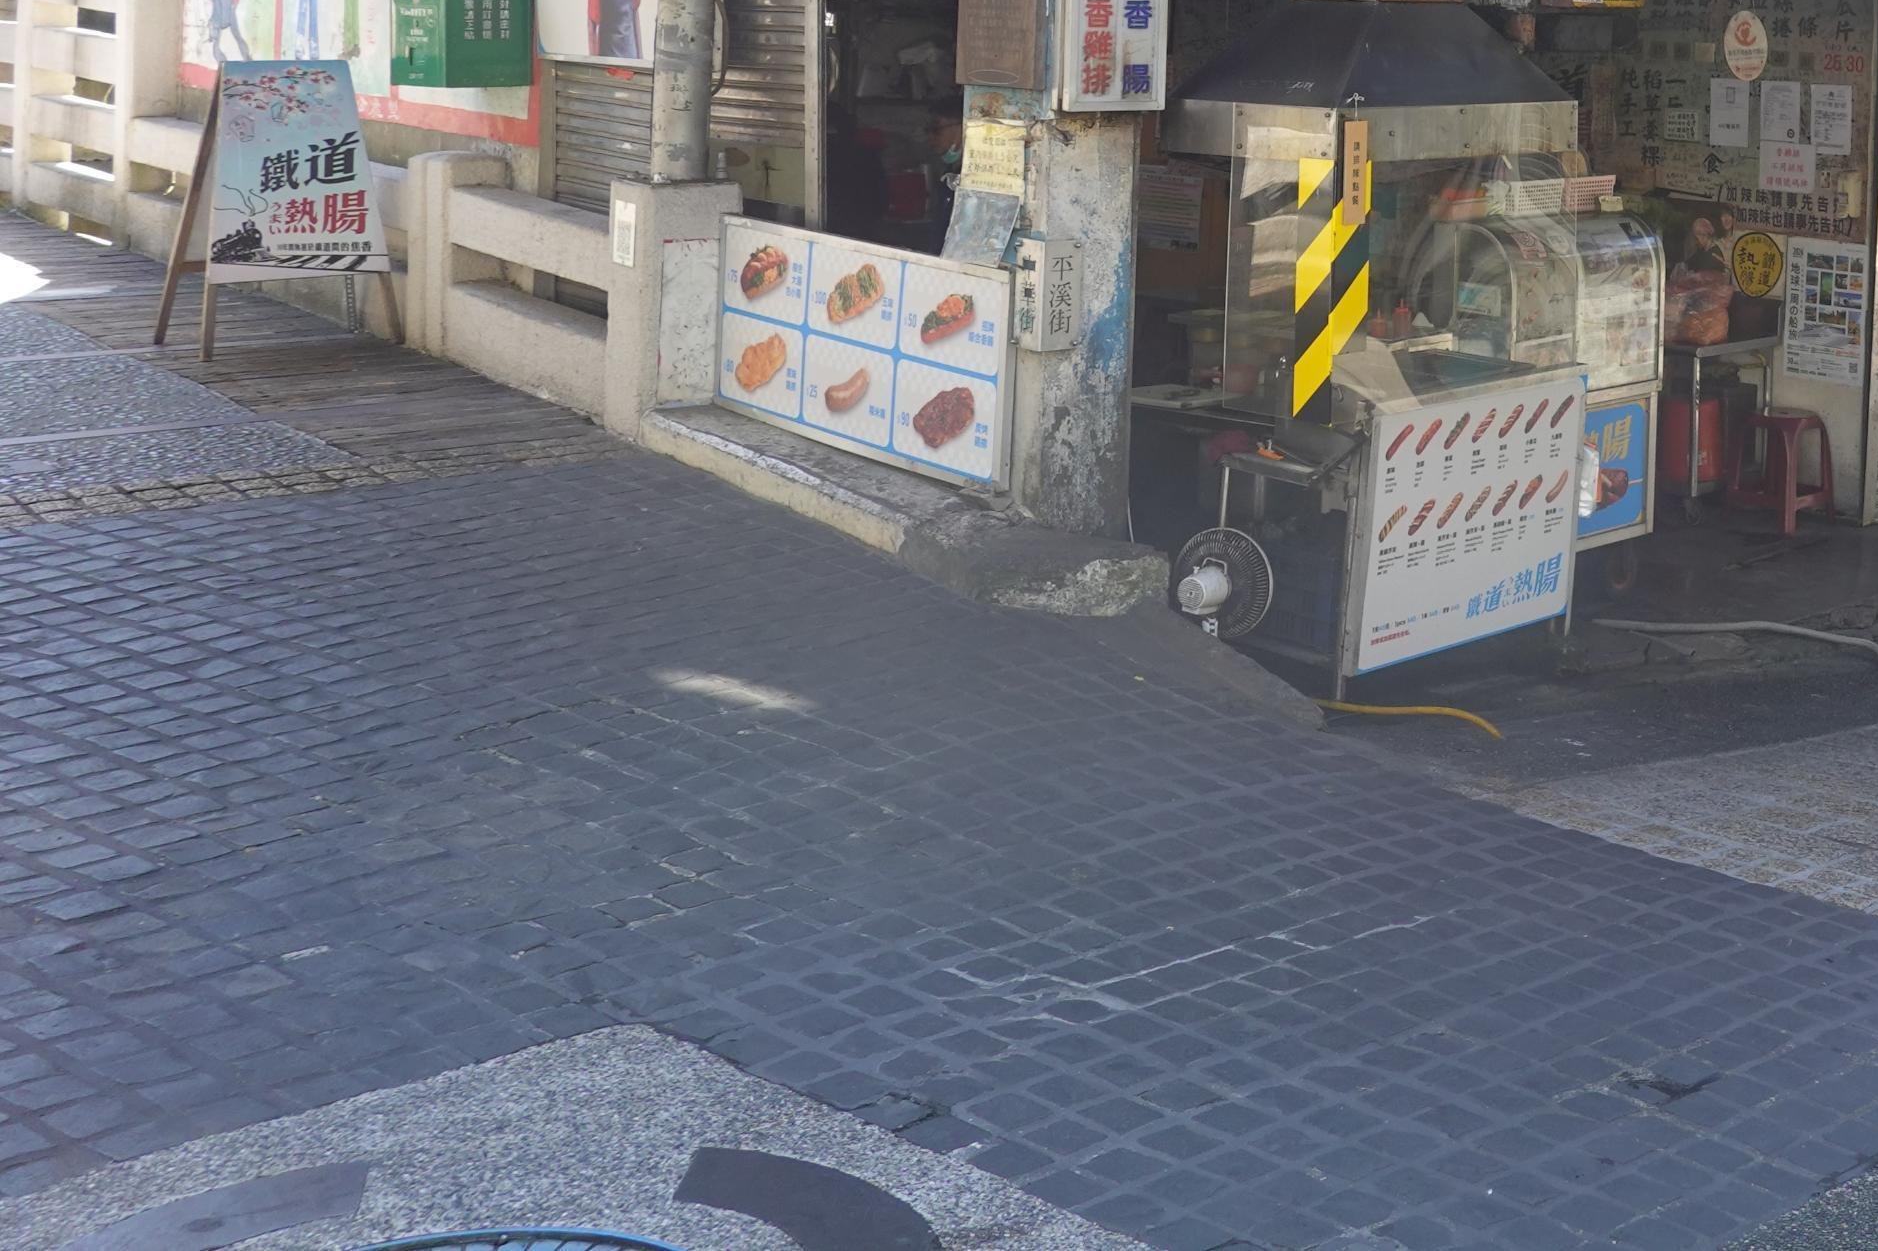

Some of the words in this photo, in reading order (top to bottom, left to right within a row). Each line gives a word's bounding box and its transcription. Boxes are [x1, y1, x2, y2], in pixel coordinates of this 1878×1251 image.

[1121, 0, 1153, 94] 香腸
[260, 130, 360, 194] 鐵道
[285, 189, 370, 235] 熱腸
[1049, 255, 1074, 336] 平溪街
[1465, 582, 1504, 620] 鐵道
[1512, 551, 1563, 606] 熱腸
